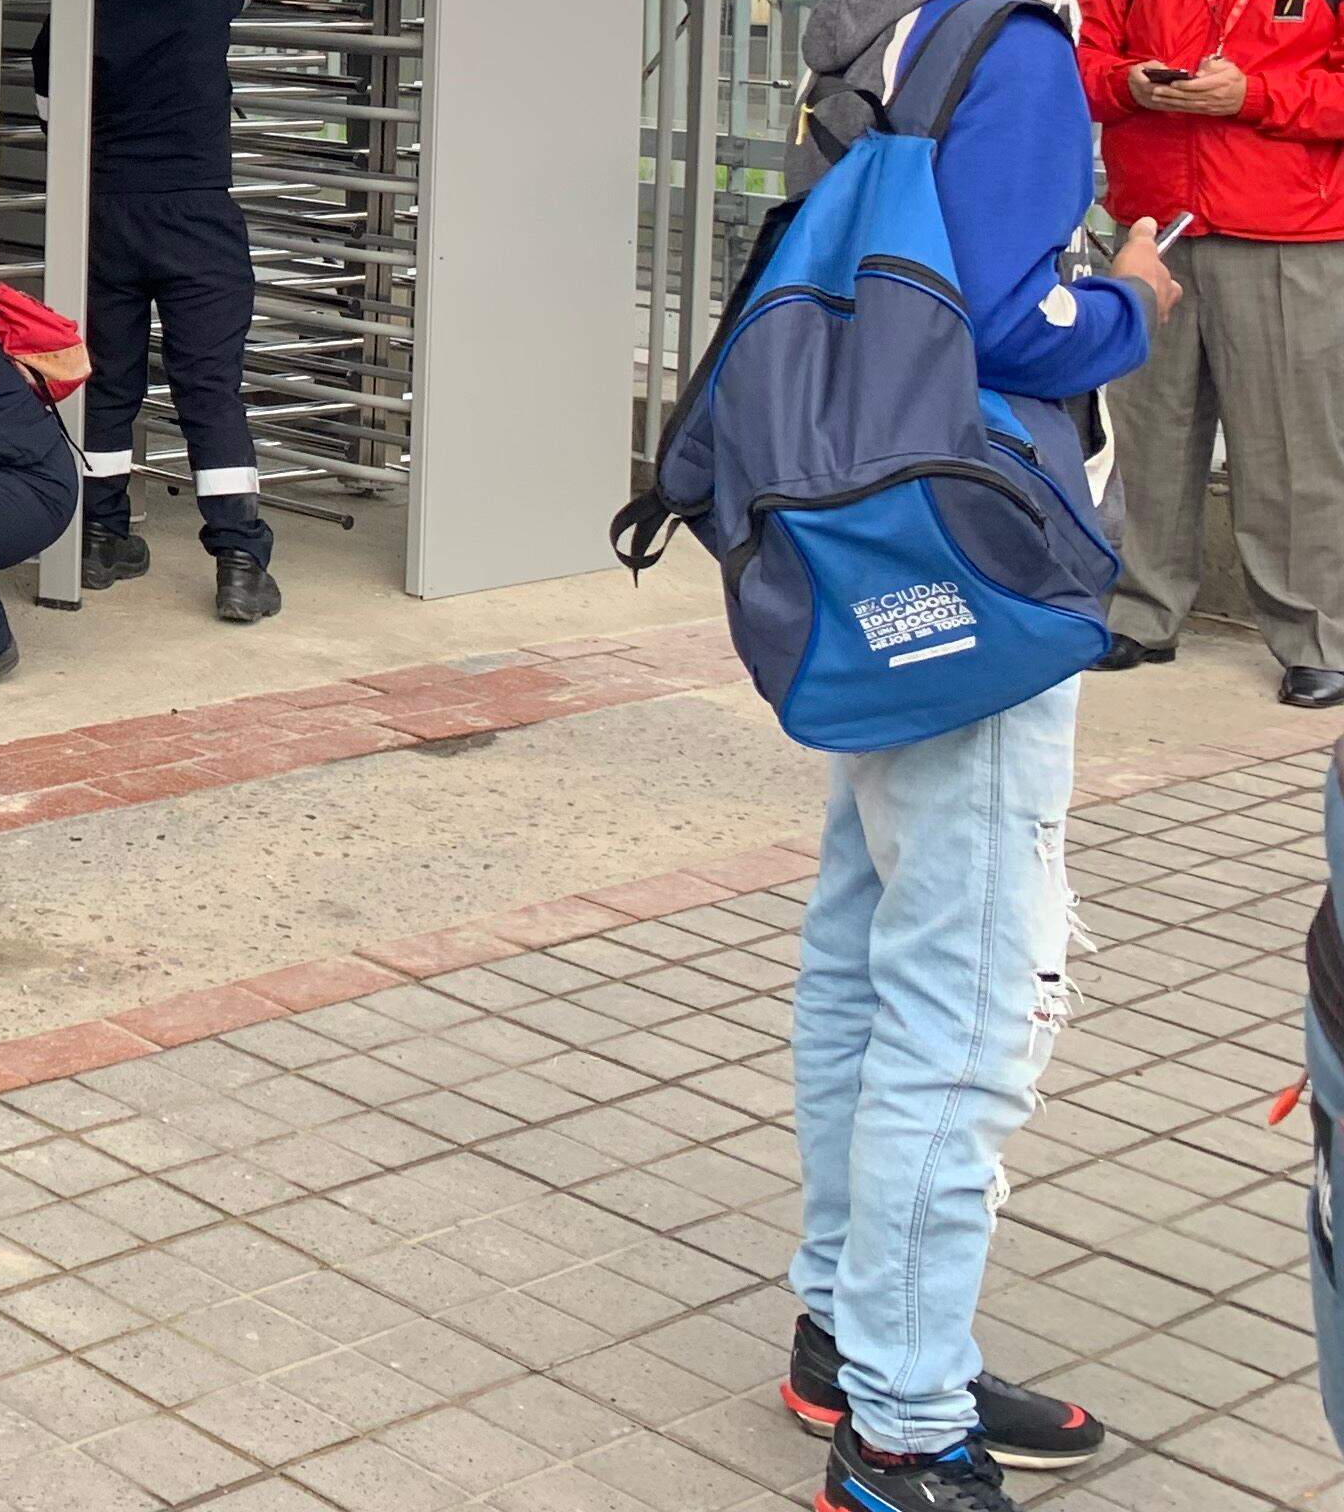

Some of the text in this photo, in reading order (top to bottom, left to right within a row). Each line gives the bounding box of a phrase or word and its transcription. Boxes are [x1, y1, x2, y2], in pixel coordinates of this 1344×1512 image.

[859, 594, 967, 630] EDUCADORA
[880, 581, 959, 609] CIUDAD
[869, 633, 912, 652] MEJOR
[934, 616, 977, 631] TODOS
